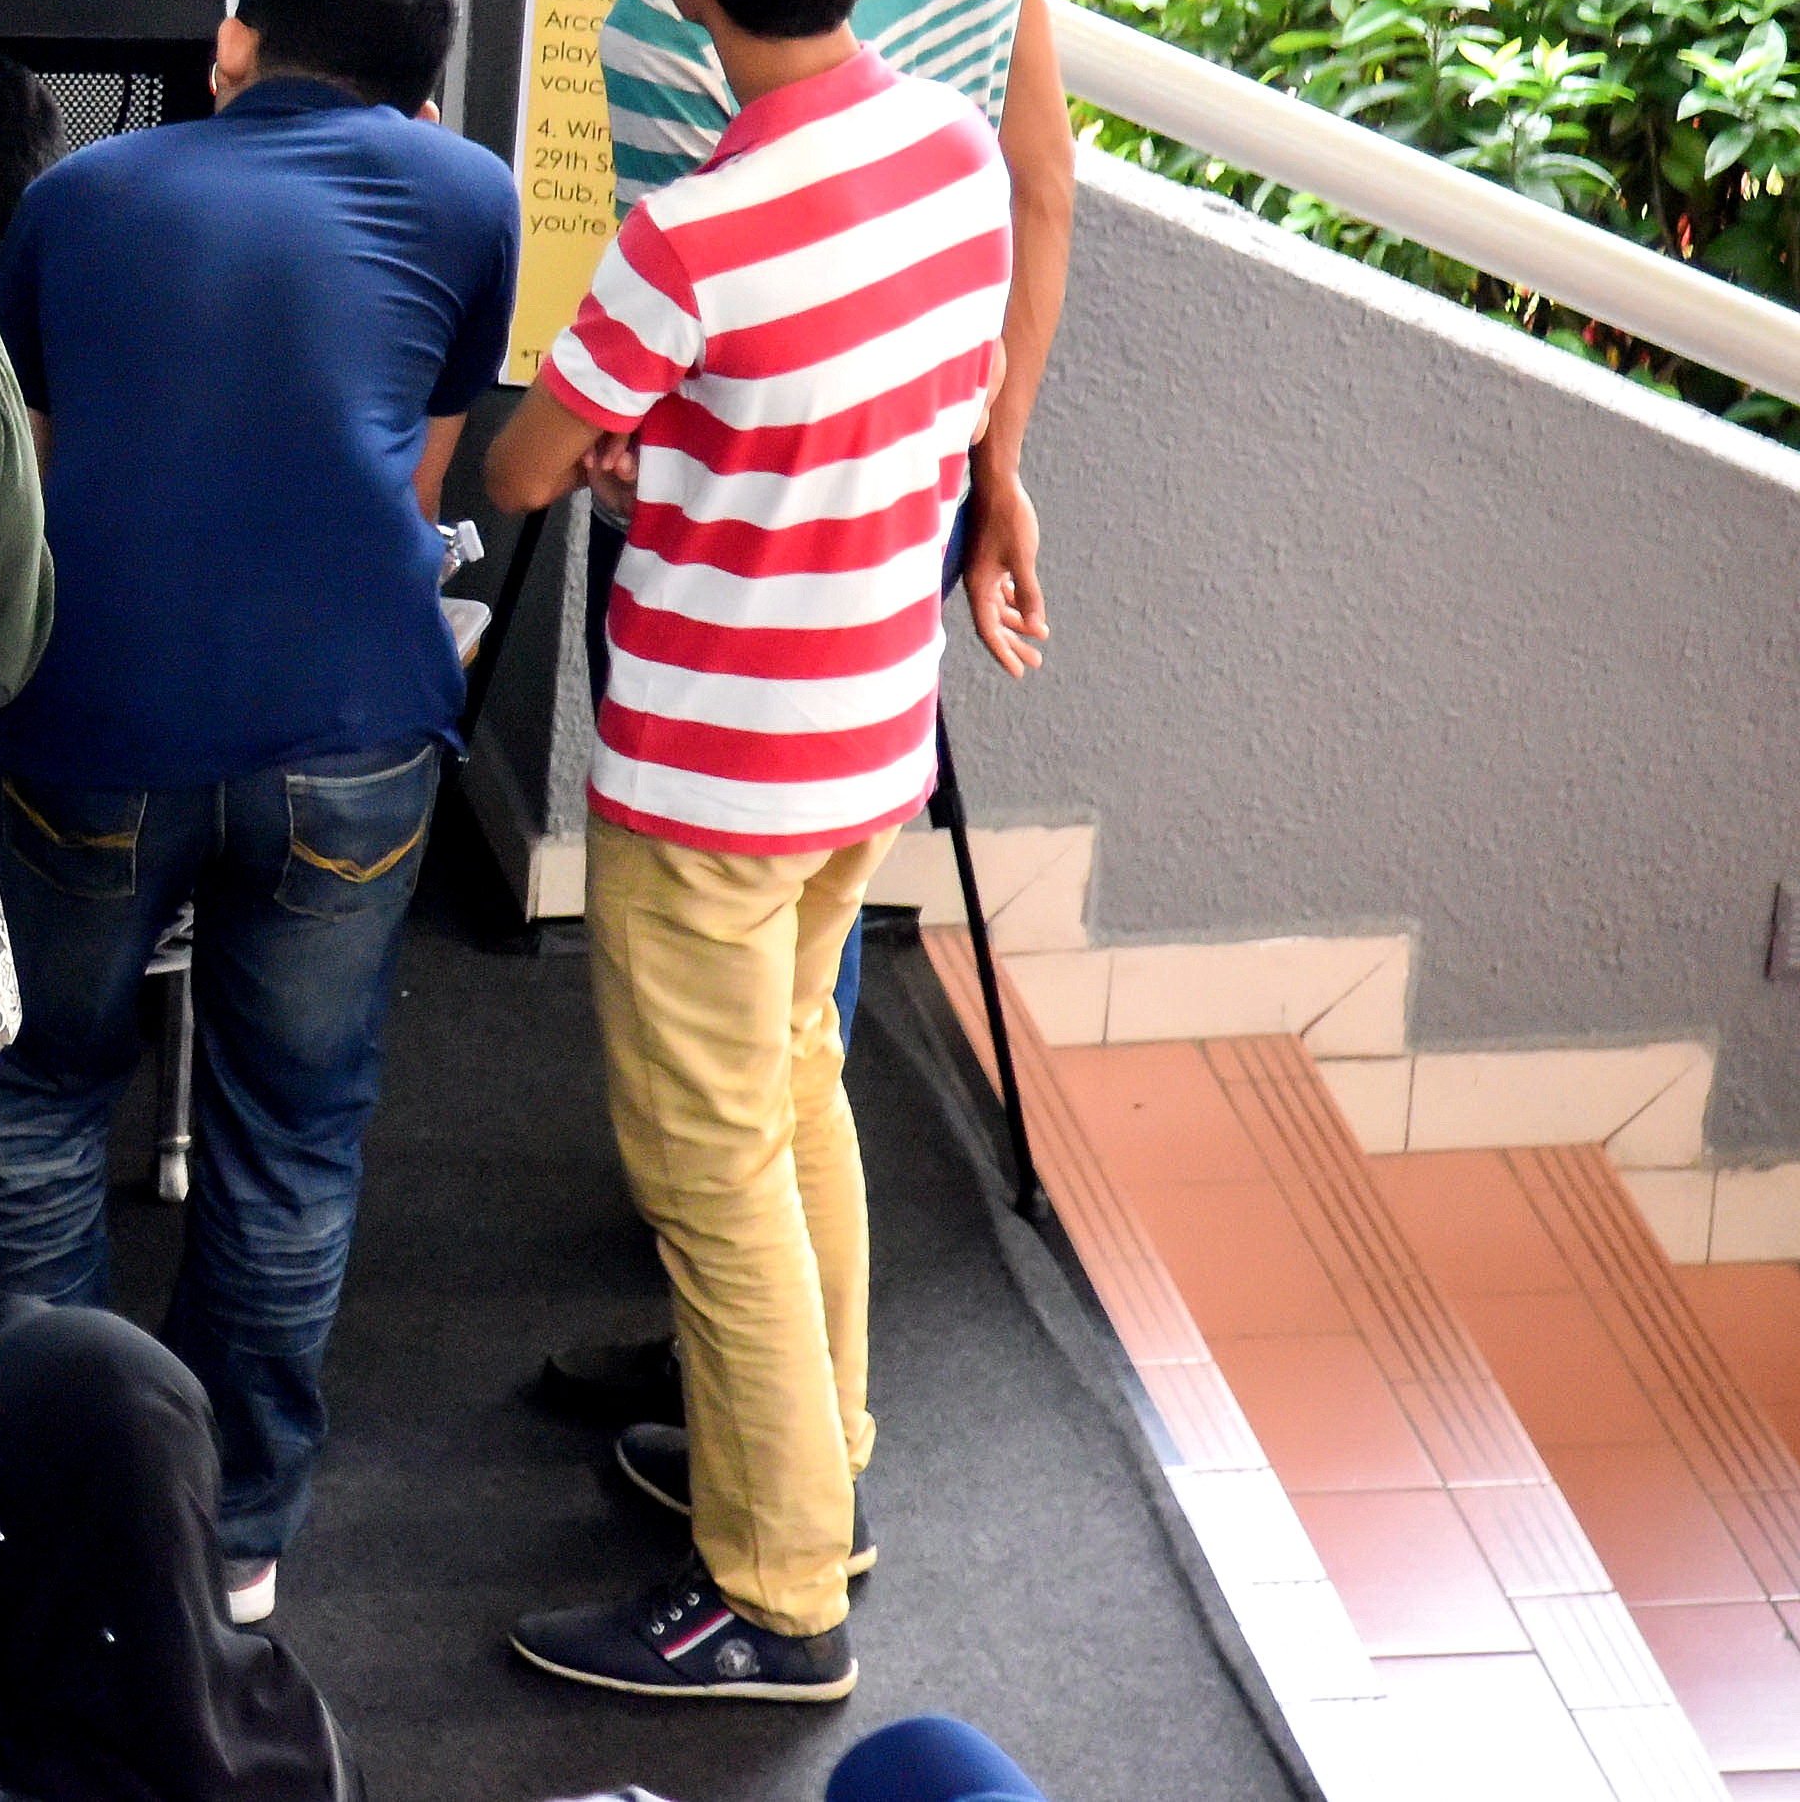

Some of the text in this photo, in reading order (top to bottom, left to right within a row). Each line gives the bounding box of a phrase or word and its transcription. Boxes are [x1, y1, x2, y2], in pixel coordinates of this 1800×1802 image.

[537, 118, 557, 139] 4.
[534, 147, 588, 172] 29th
[532, 179, 599, 207] Club,
[529, 213, 607, 237] you're
